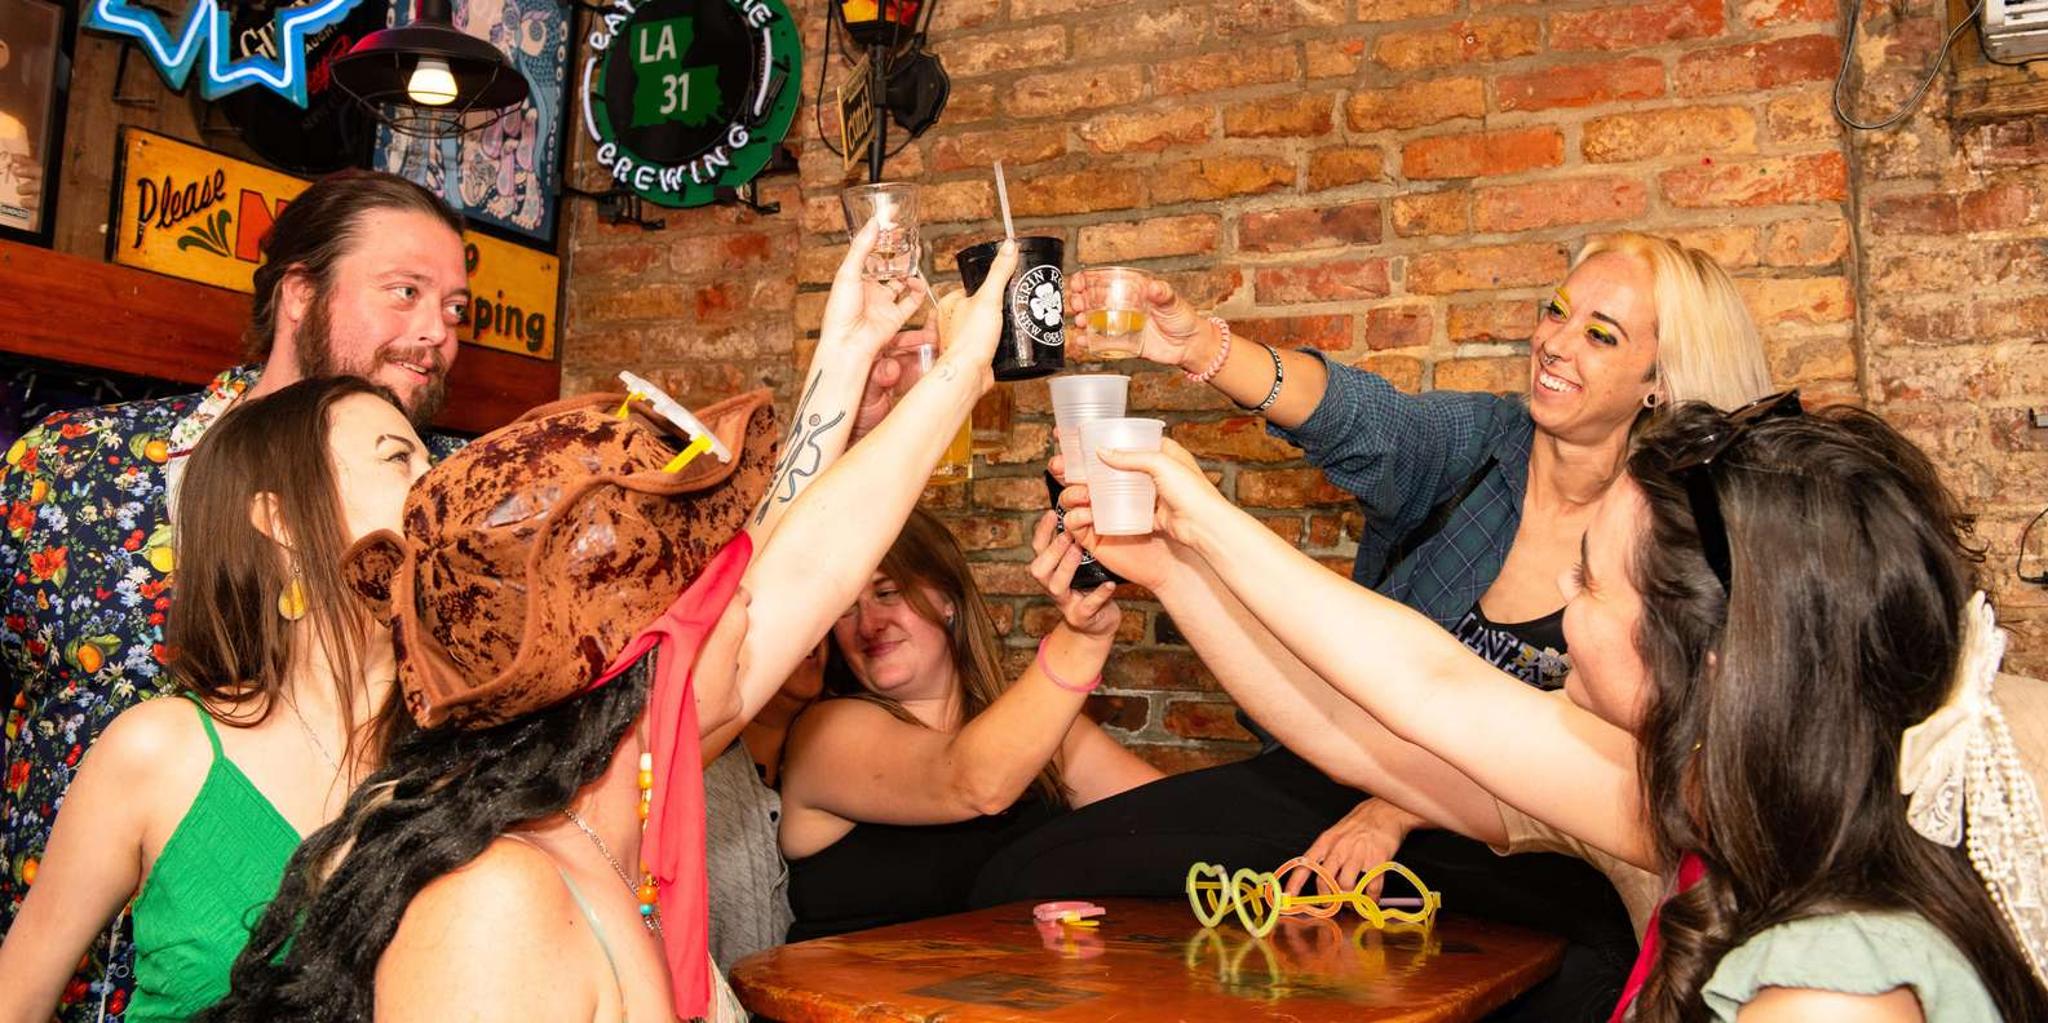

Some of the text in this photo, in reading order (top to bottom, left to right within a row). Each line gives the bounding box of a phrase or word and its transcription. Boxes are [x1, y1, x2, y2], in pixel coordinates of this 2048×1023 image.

[639, 24, 678, 64] LA
[659, 72, 690, 115] 31
[596, 124, 749, 193] BREWING
[132, 168, 227, 249] Please
[1017, 269, 1045, 304] ERIN
[466, 289, 546, 353] ping
